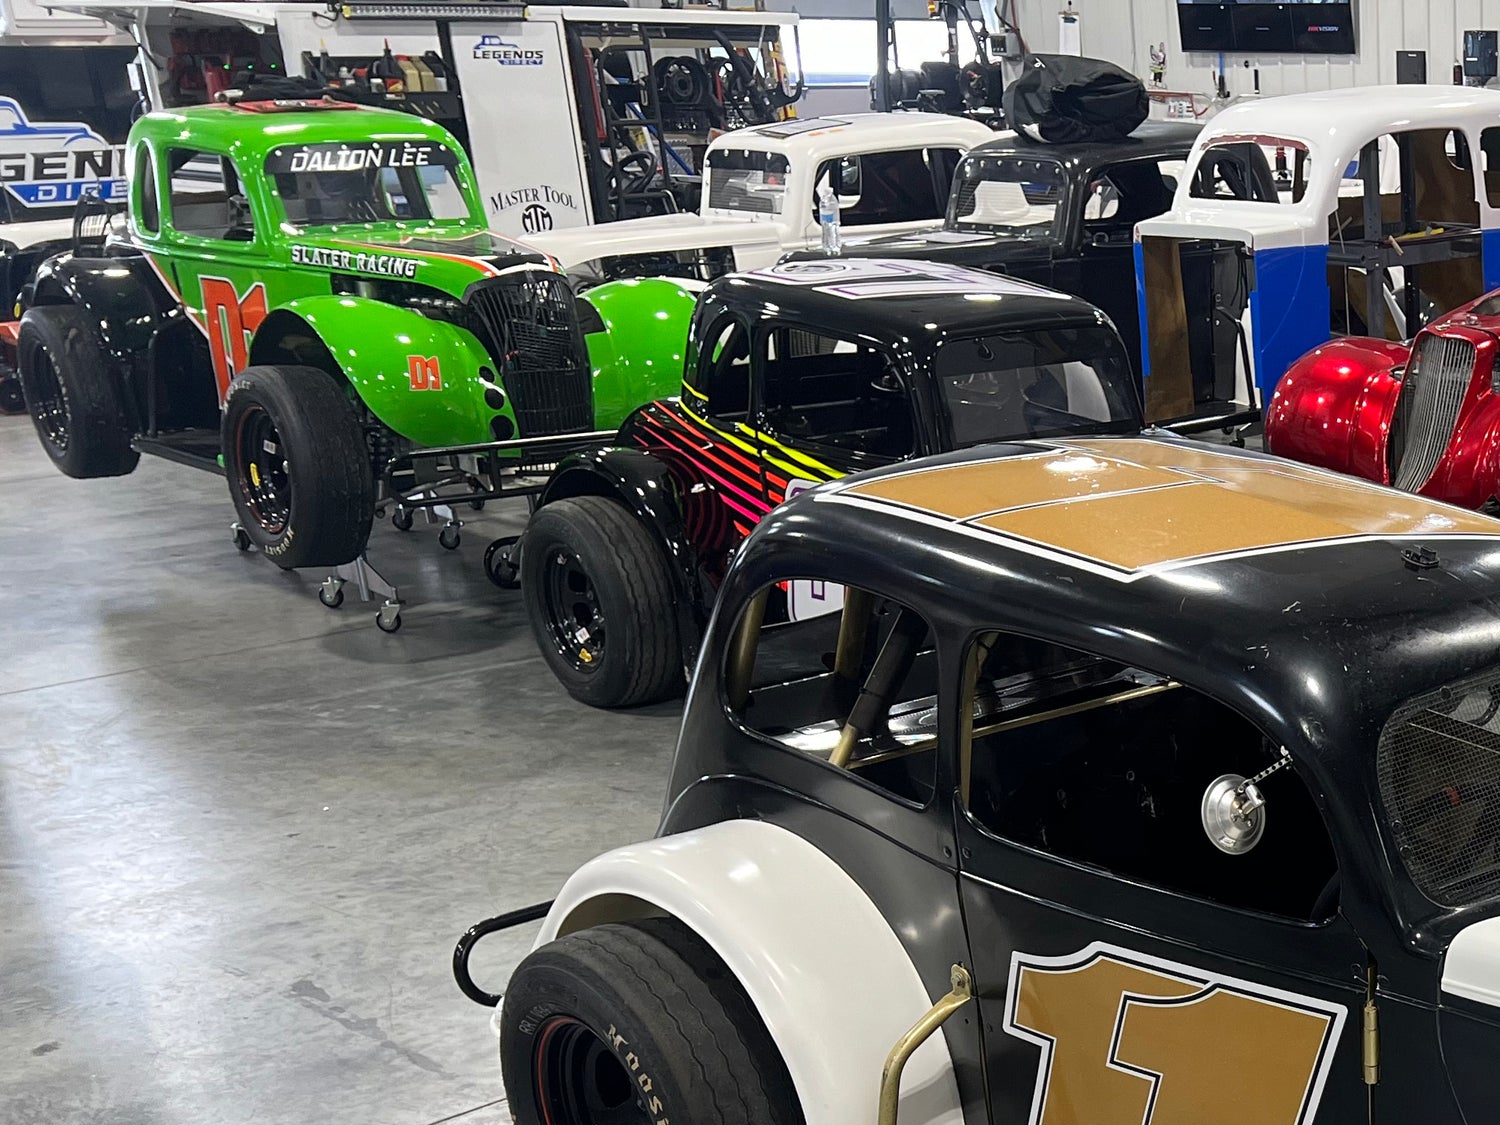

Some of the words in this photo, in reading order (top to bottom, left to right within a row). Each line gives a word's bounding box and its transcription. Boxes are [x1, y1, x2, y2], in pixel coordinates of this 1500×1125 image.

[473, 50, 544, 59] LEGENDS
[0, 149, 125, 182] GEN
[290, 149, 383, 172] DALTON
[388, 147, 432, 167] LEE
[490, 188, 538, 215] MASTER
[541, 184, 578, 211] TOOL
[291, 245, 350, 269] SLATER
[356, 256, 417, 278] RACING
